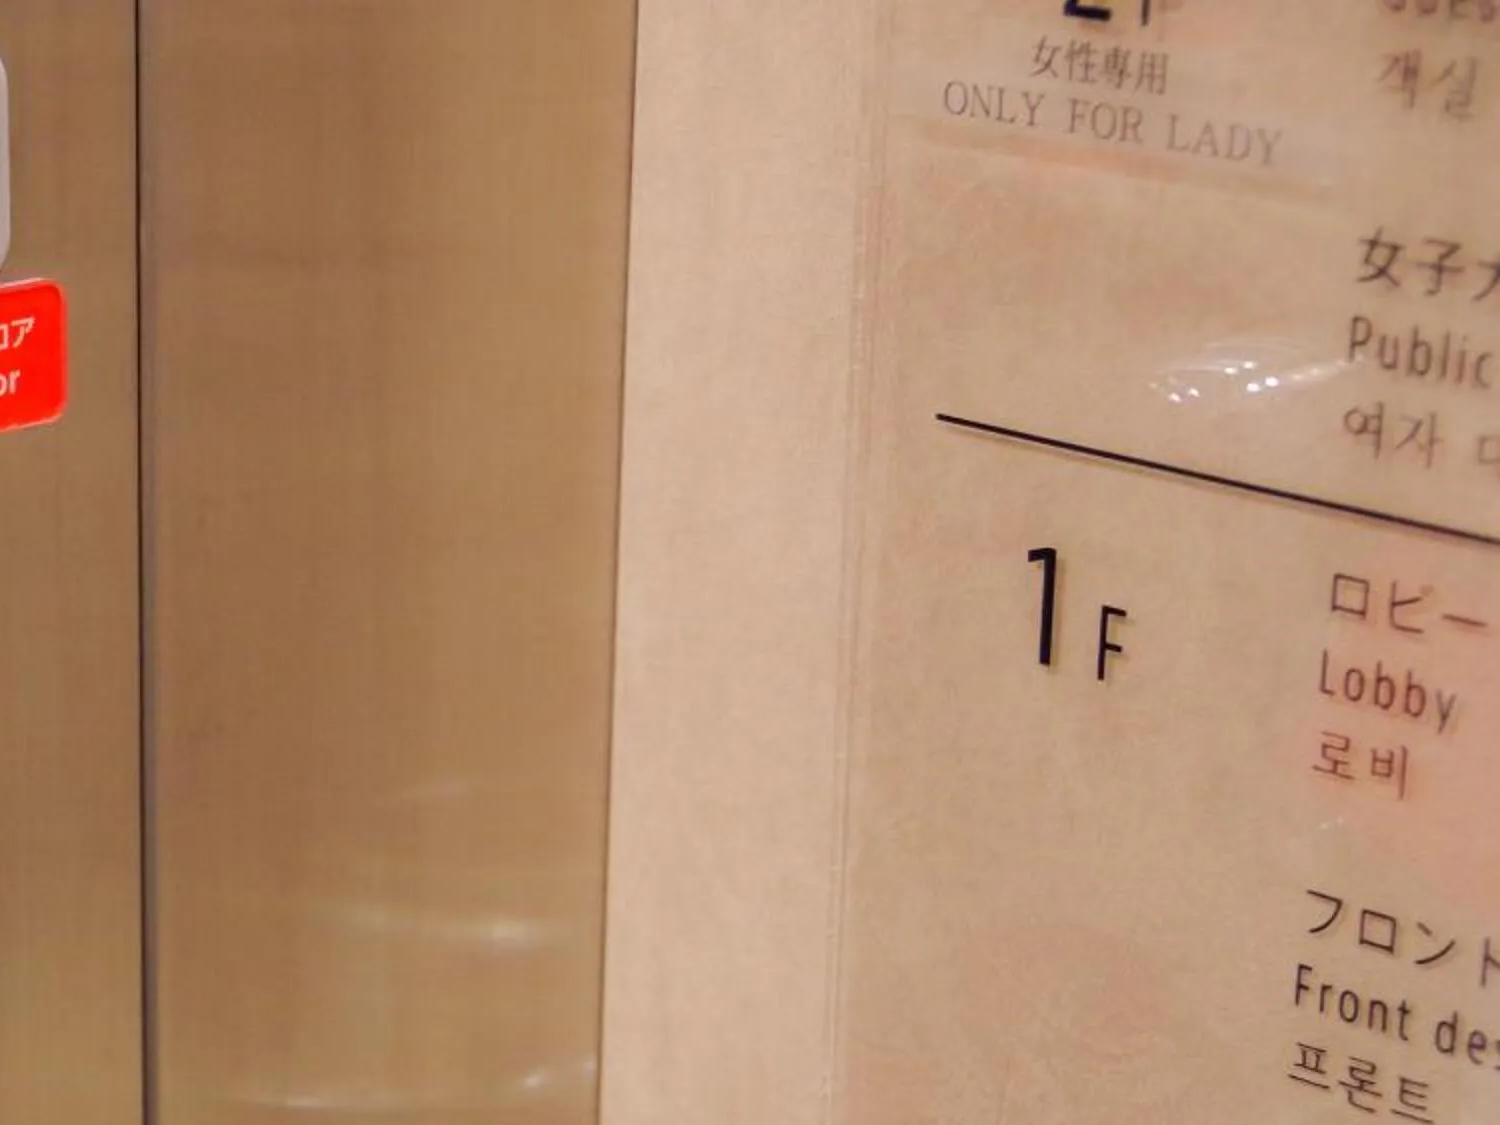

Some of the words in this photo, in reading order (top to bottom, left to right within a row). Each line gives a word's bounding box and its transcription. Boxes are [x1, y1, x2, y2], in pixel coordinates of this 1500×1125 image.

[943, 79, 1045, 128] ONLY
[1068, 101, 1144, 145] FOR
[1168, 114, 1284, 168] LADY
[1348, 315, 1494, 389] Public
[1343, 401, 1444, 470] 여자
[1330, 572, 1489, 635] ロビー
[1318, 648, 1460, 735] Lobby
[1311, 731, 1411, 801] 로비
[1306, 888, 1500, 989] フロント
[1293, 963, 1412, 1043] Front
[1434, 1010, 1500, 1073] de
[1287, 1041, 1435, 1125] 프론트
